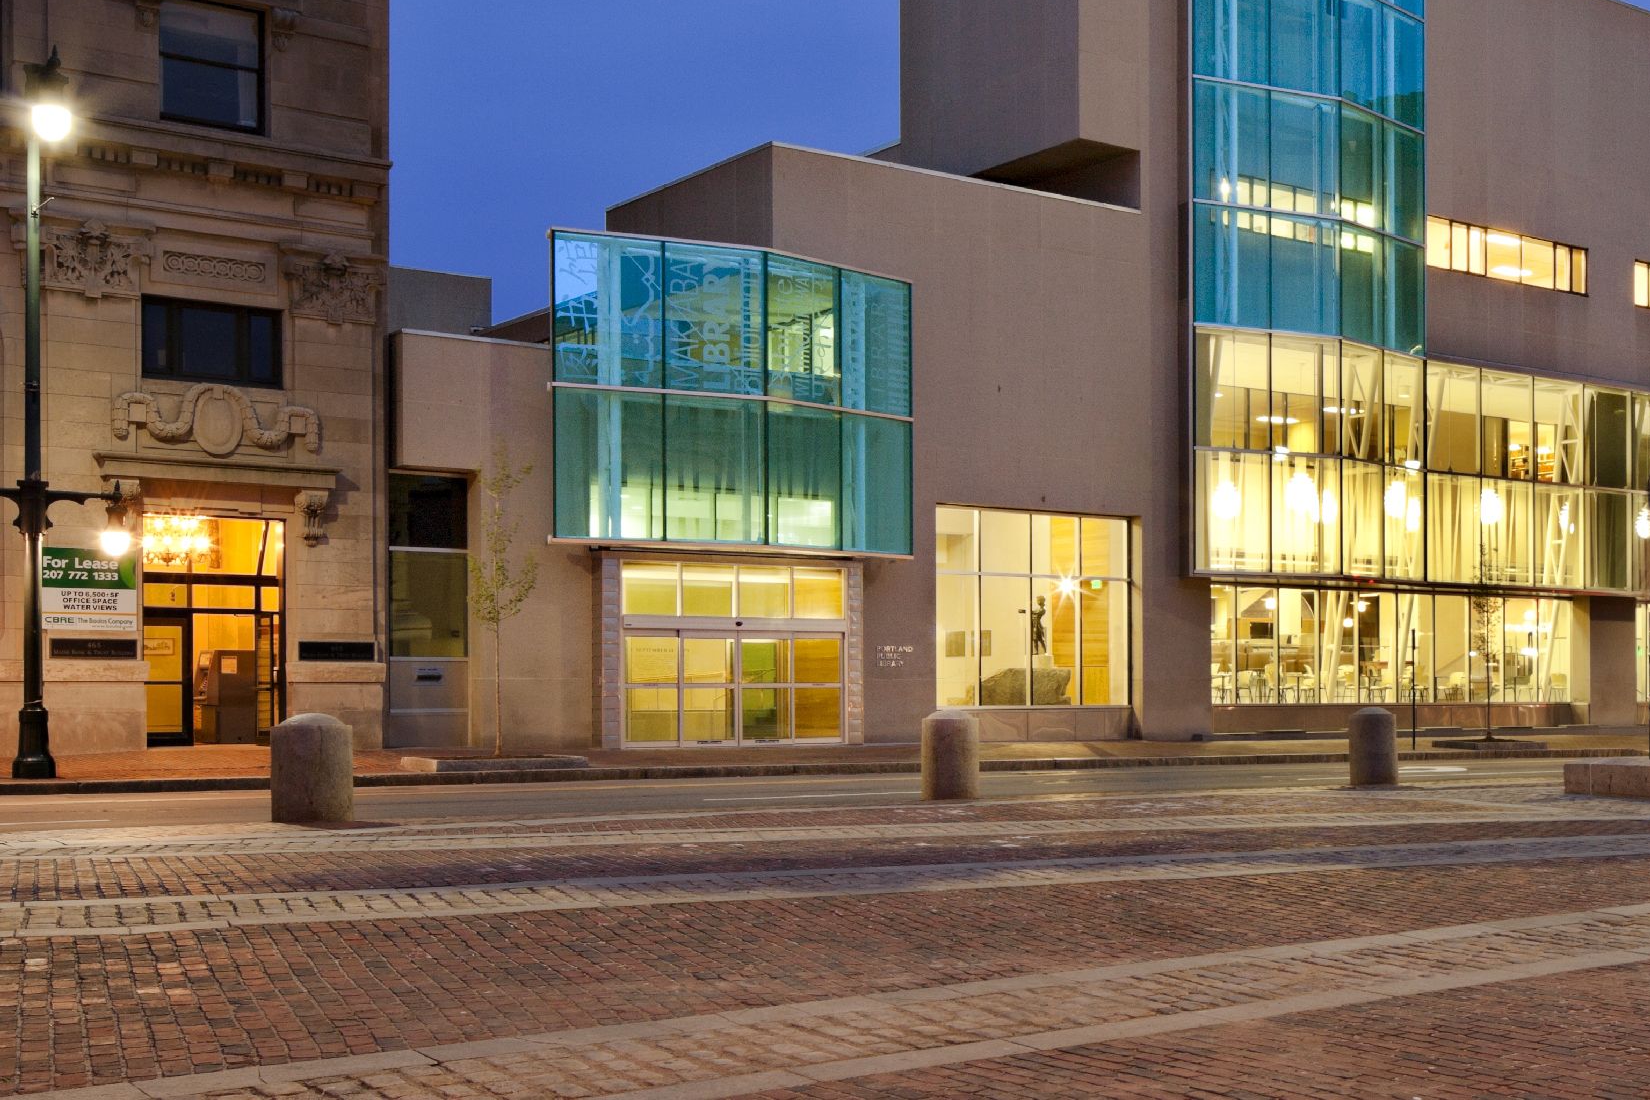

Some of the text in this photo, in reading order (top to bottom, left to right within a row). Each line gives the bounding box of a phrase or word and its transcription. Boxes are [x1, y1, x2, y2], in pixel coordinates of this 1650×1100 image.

[702, 253, 730, 390] LIBRARY
[42, 556, 119, 570] For Lease
[42, 570, 119, 580] 207 772 1333
